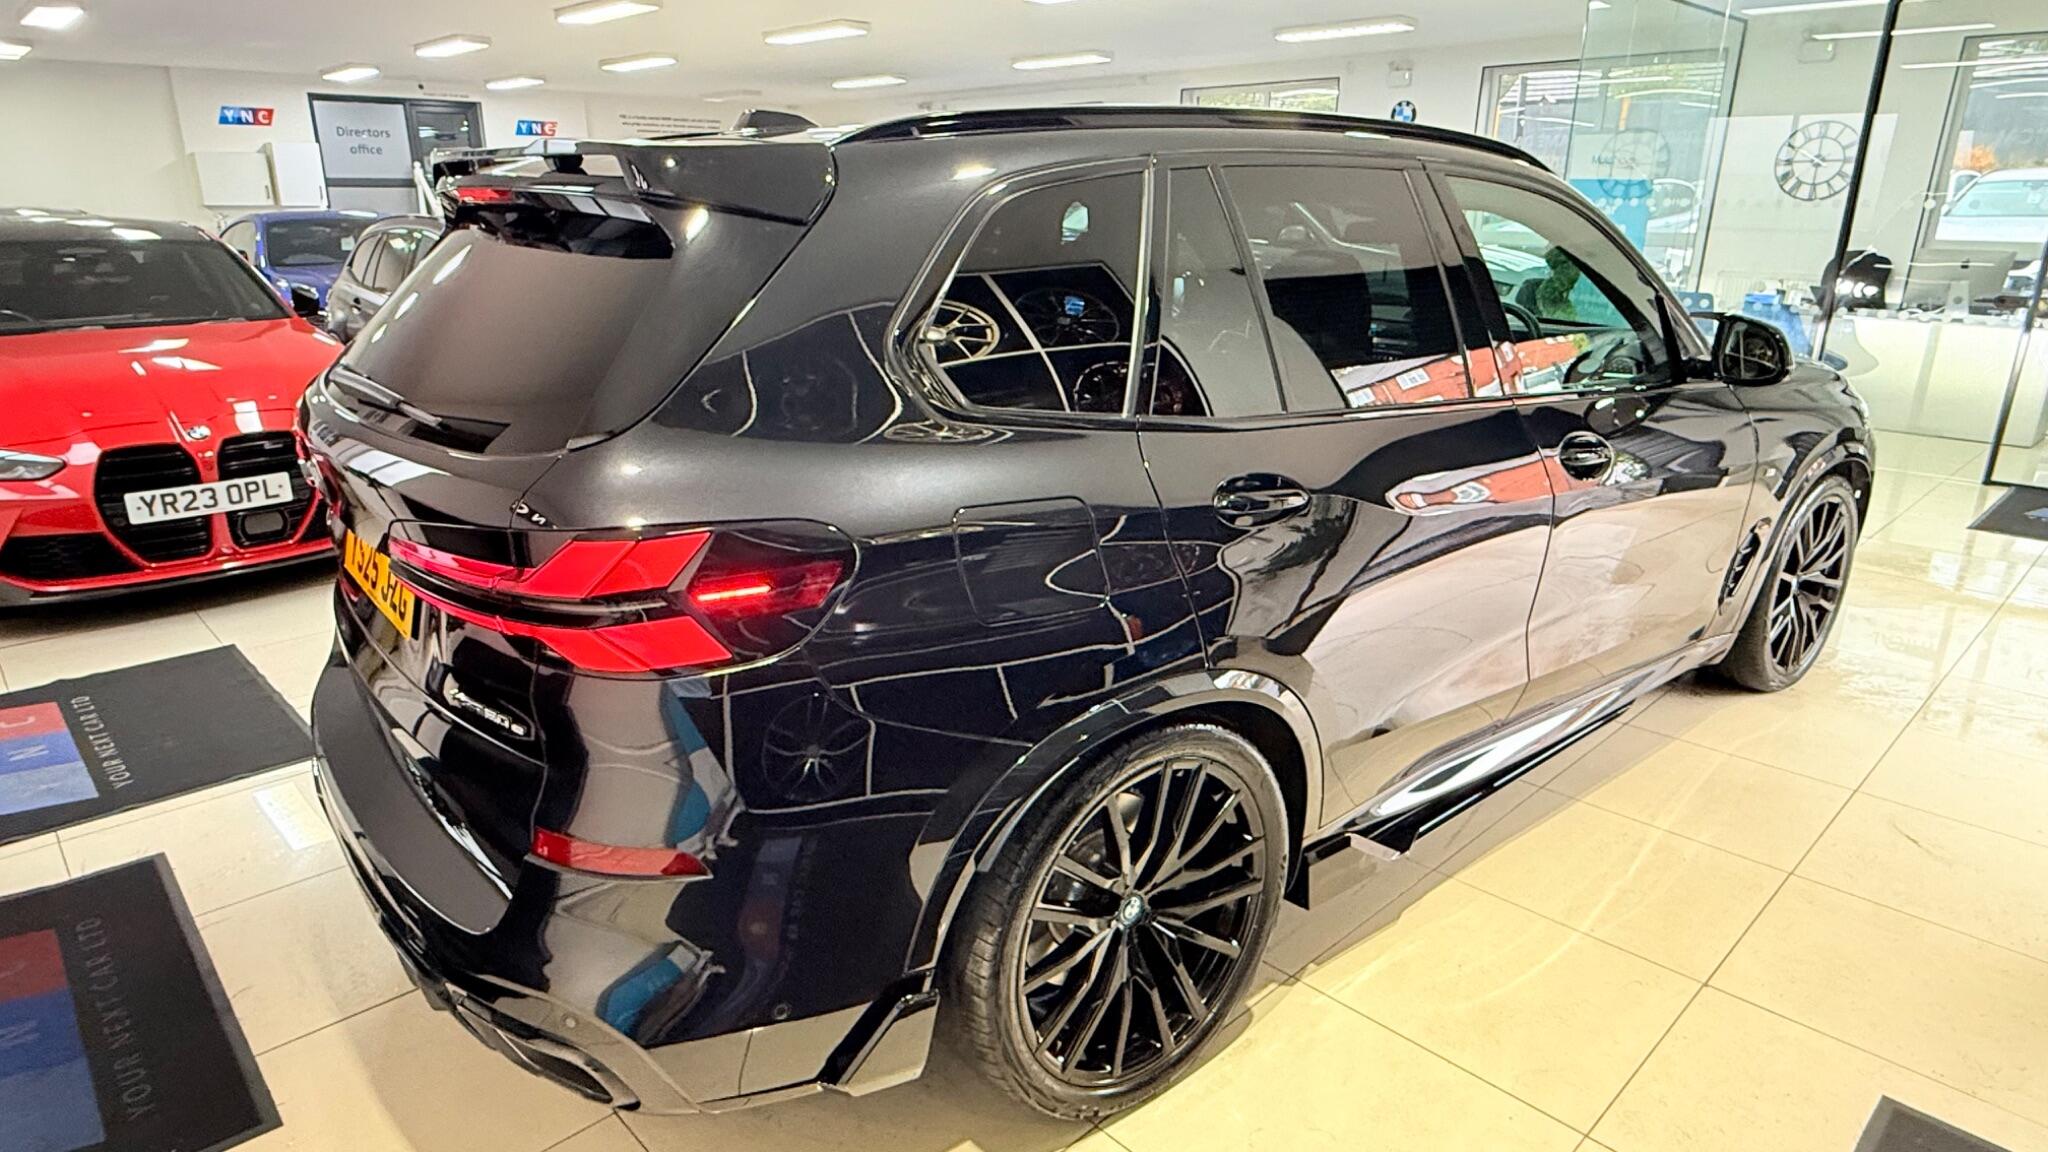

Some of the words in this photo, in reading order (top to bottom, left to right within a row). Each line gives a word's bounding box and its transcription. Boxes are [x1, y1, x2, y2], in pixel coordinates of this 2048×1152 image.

[223, 109, 270, 124] YNC
[519, 122, 555, 135] YNC
[336, 126, 391, 138] Directors
[350, 143, 383, 155] office
[139, 487, 219, 517] YR23
[226, 479, 280, 505] OPL
[70, 696, 95, 713] LTD
[80, 712, 104, 732] CAR
[88, 732, 119, 758] NEXT
[102, 758, 135, 790] YOUR
[76, 917, 107, 951] LTD
[86, 953, 119, 991] CAR
[95, 998, 134, 1051] NEXT
[113, 1052, 155, 1121] YOUR
